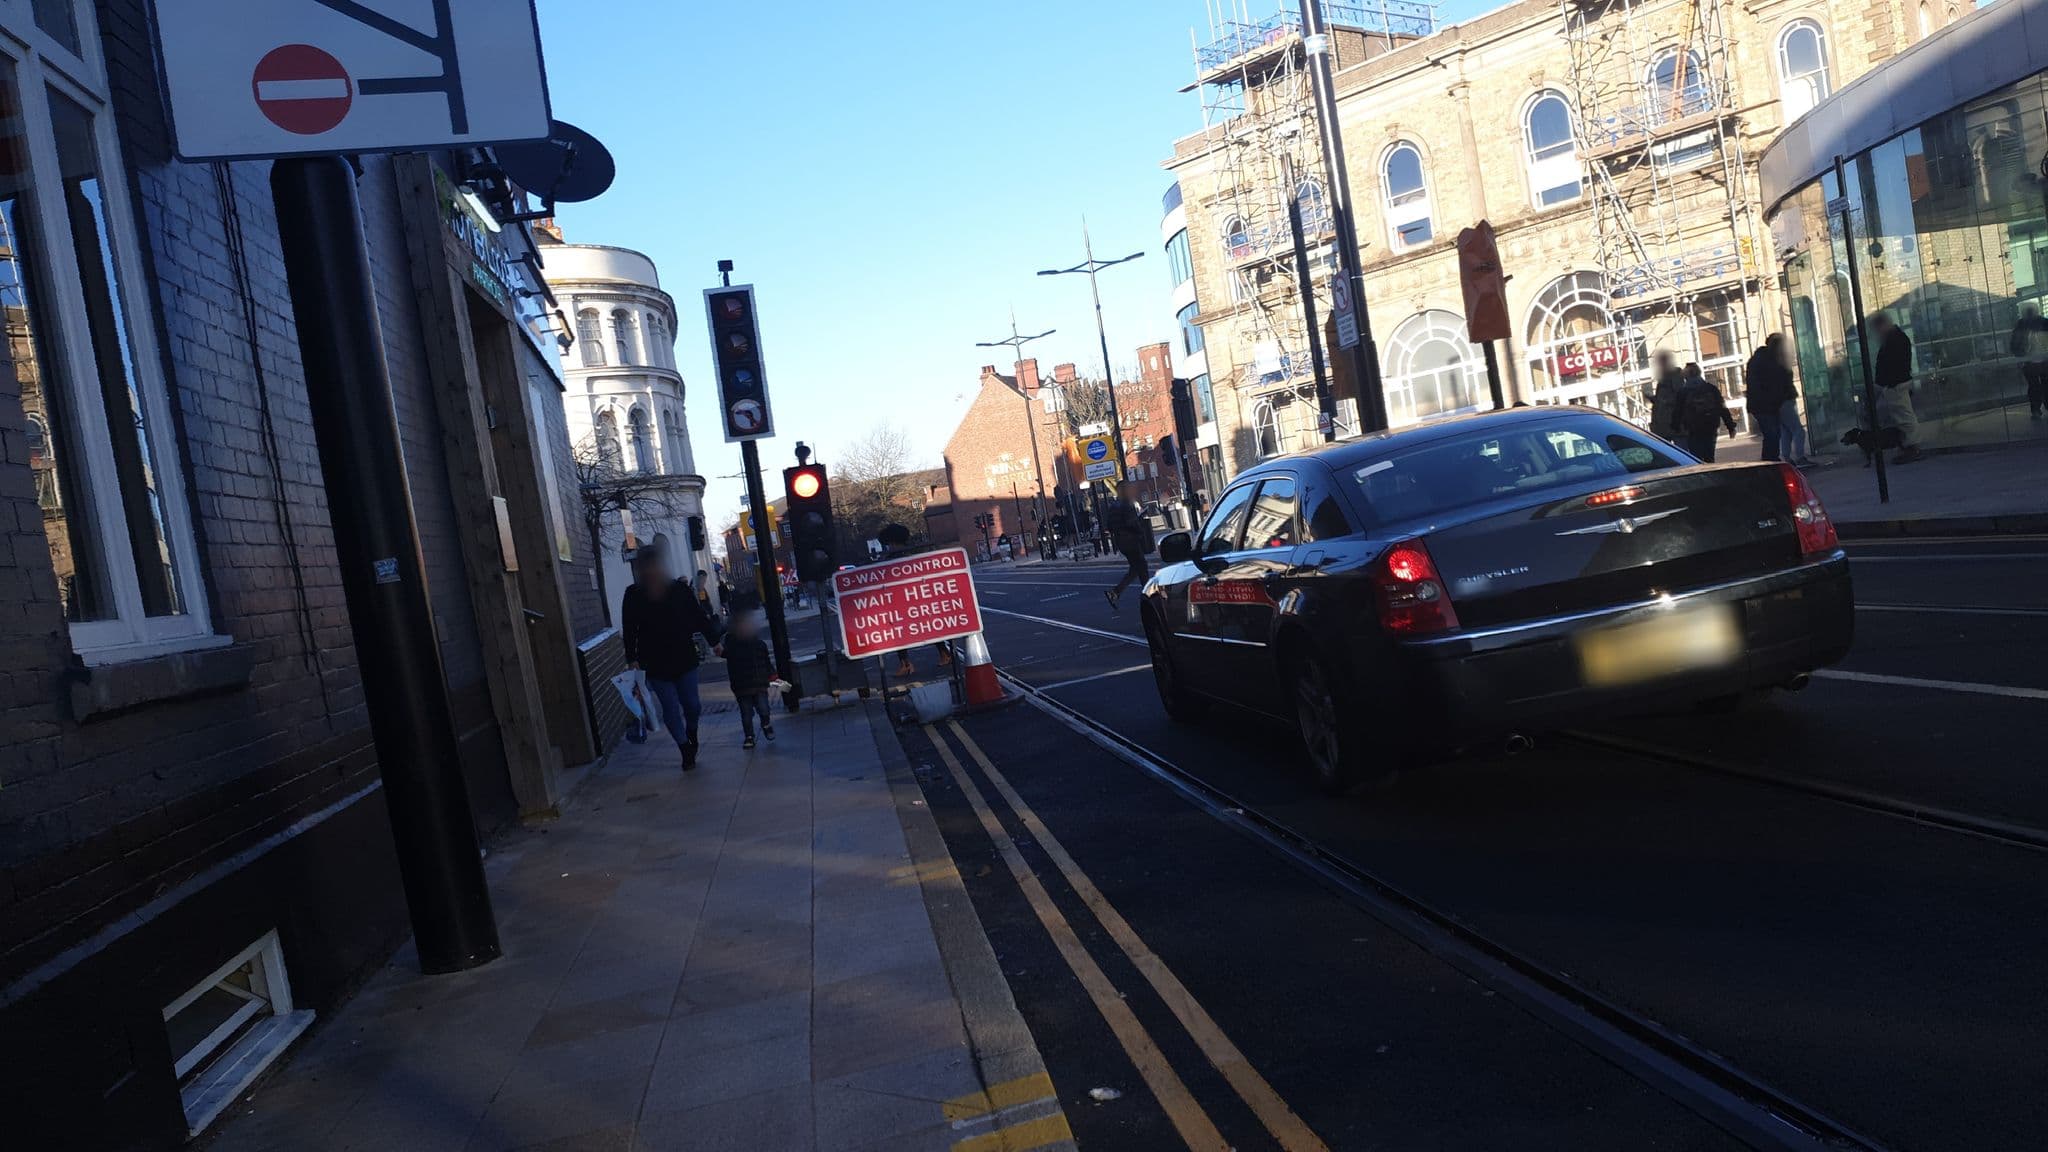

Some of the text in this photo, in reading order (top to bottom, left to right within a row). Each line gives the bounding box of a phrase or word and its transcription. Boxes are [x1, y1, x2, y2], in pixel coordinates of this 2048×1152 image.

[1115, 383, 1152, 396] WORKS
[842, 555, 960, 587] 3-WAY CONTROL
[854, 578, 959, 610] WAIT HERE
[854, 598, 964, 629] UNTIL GREEN
[856, 614, 969, 647] LIGHT SHOWS
